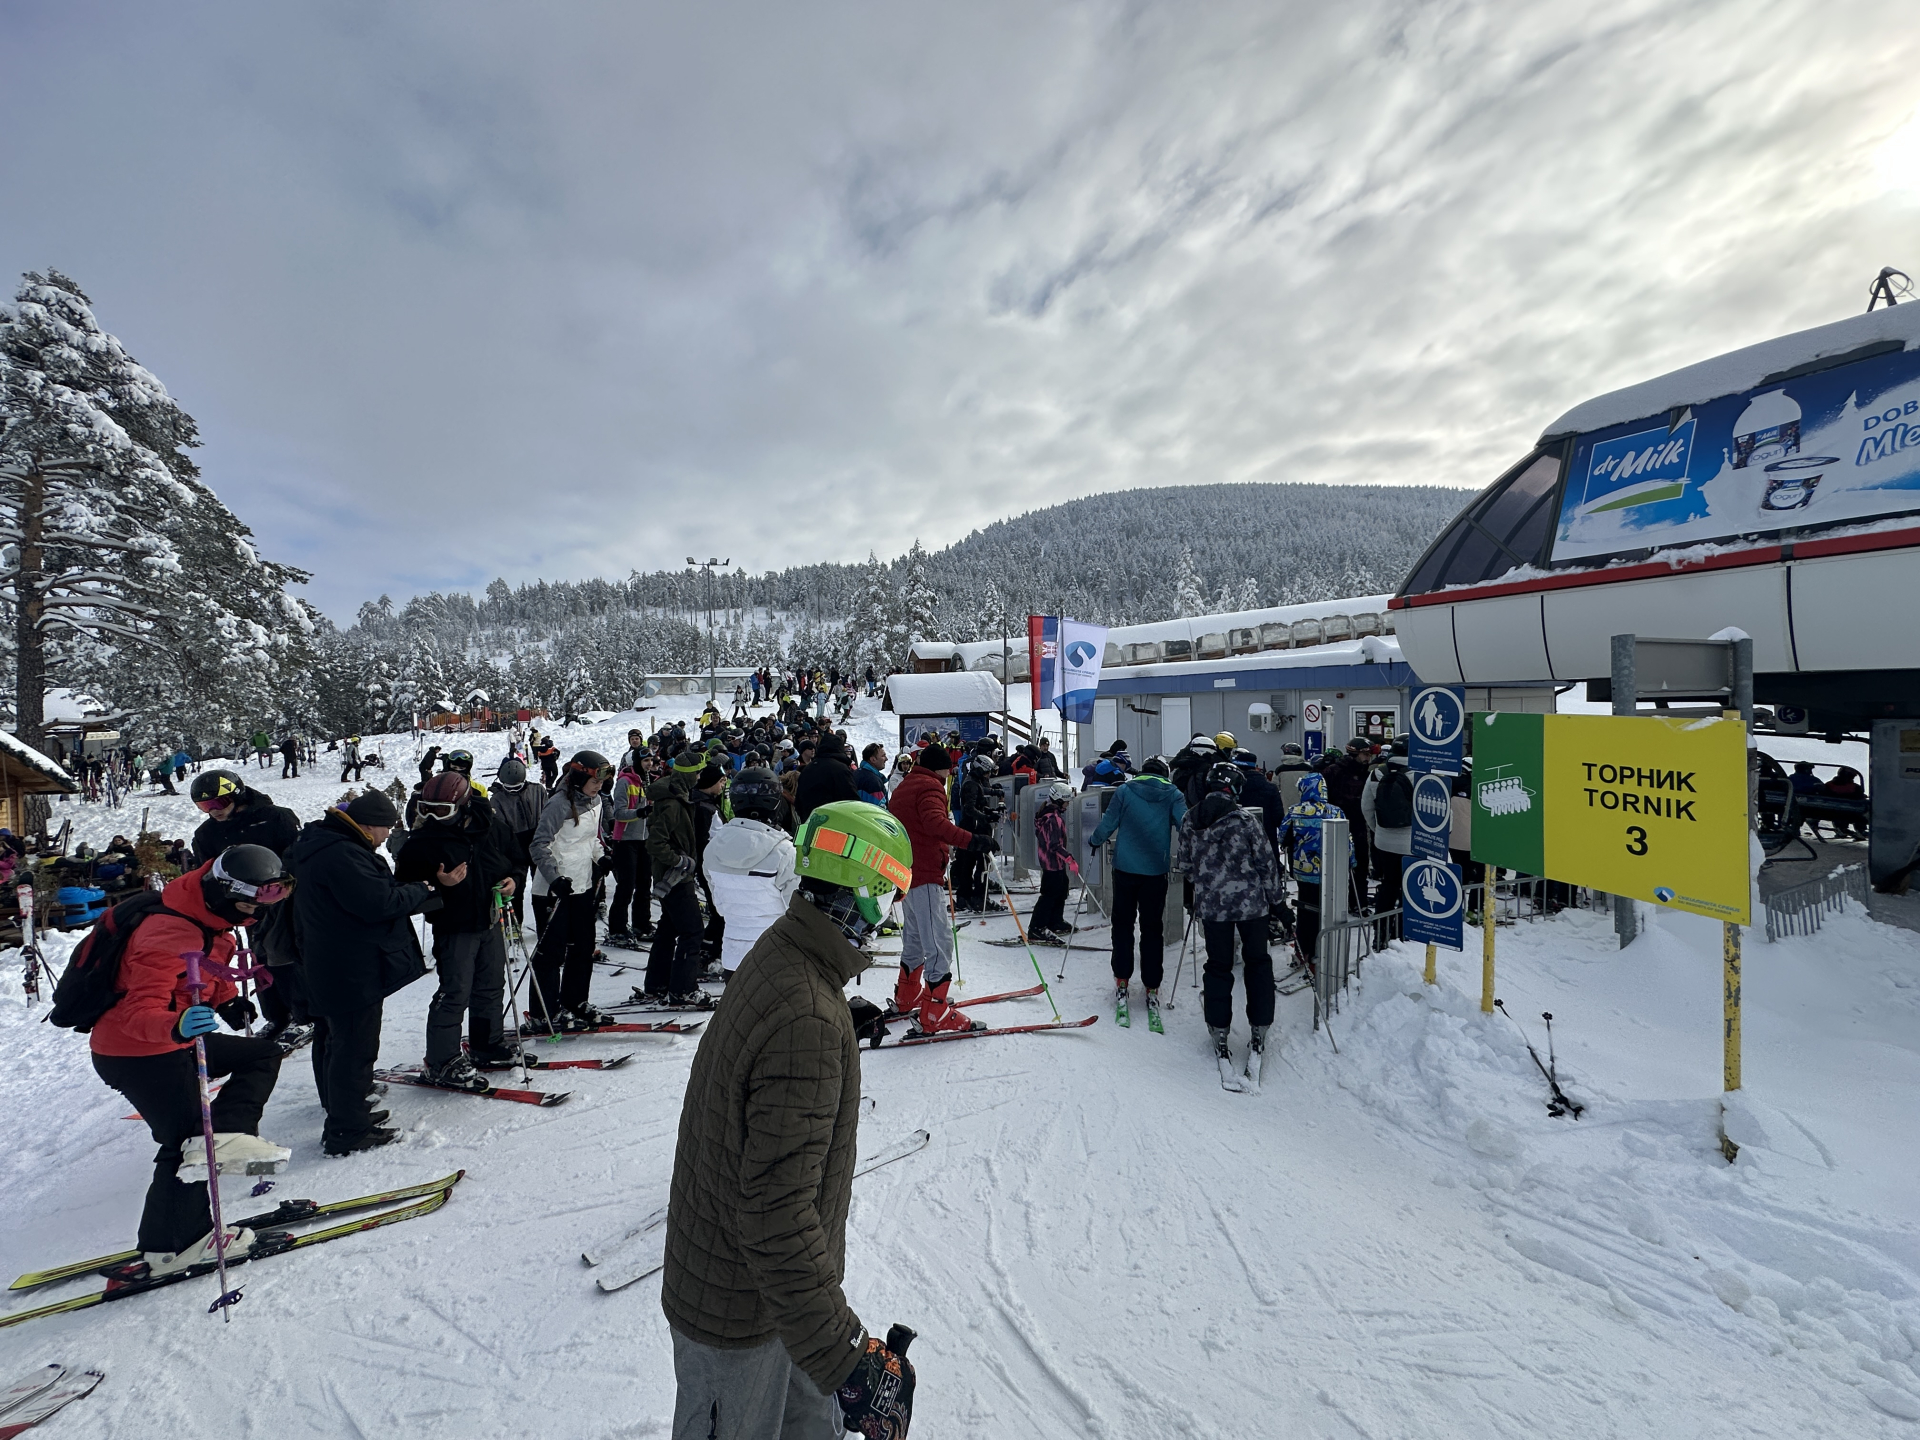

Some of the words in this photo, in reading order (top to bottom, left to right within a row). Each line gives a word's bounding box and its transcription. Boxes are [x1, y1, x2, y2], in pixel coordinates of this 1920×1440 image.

[1863, 400, 1919, 431] DOB
[1609, 438, 1685, 482] Milk
[1581, 762, 1697, 793] ТОРНИК
[1583, 787, 1697, 822] TORNIK
[1625, 825, 1649, 856] 3
[885, 863, 907, 883] uvex
